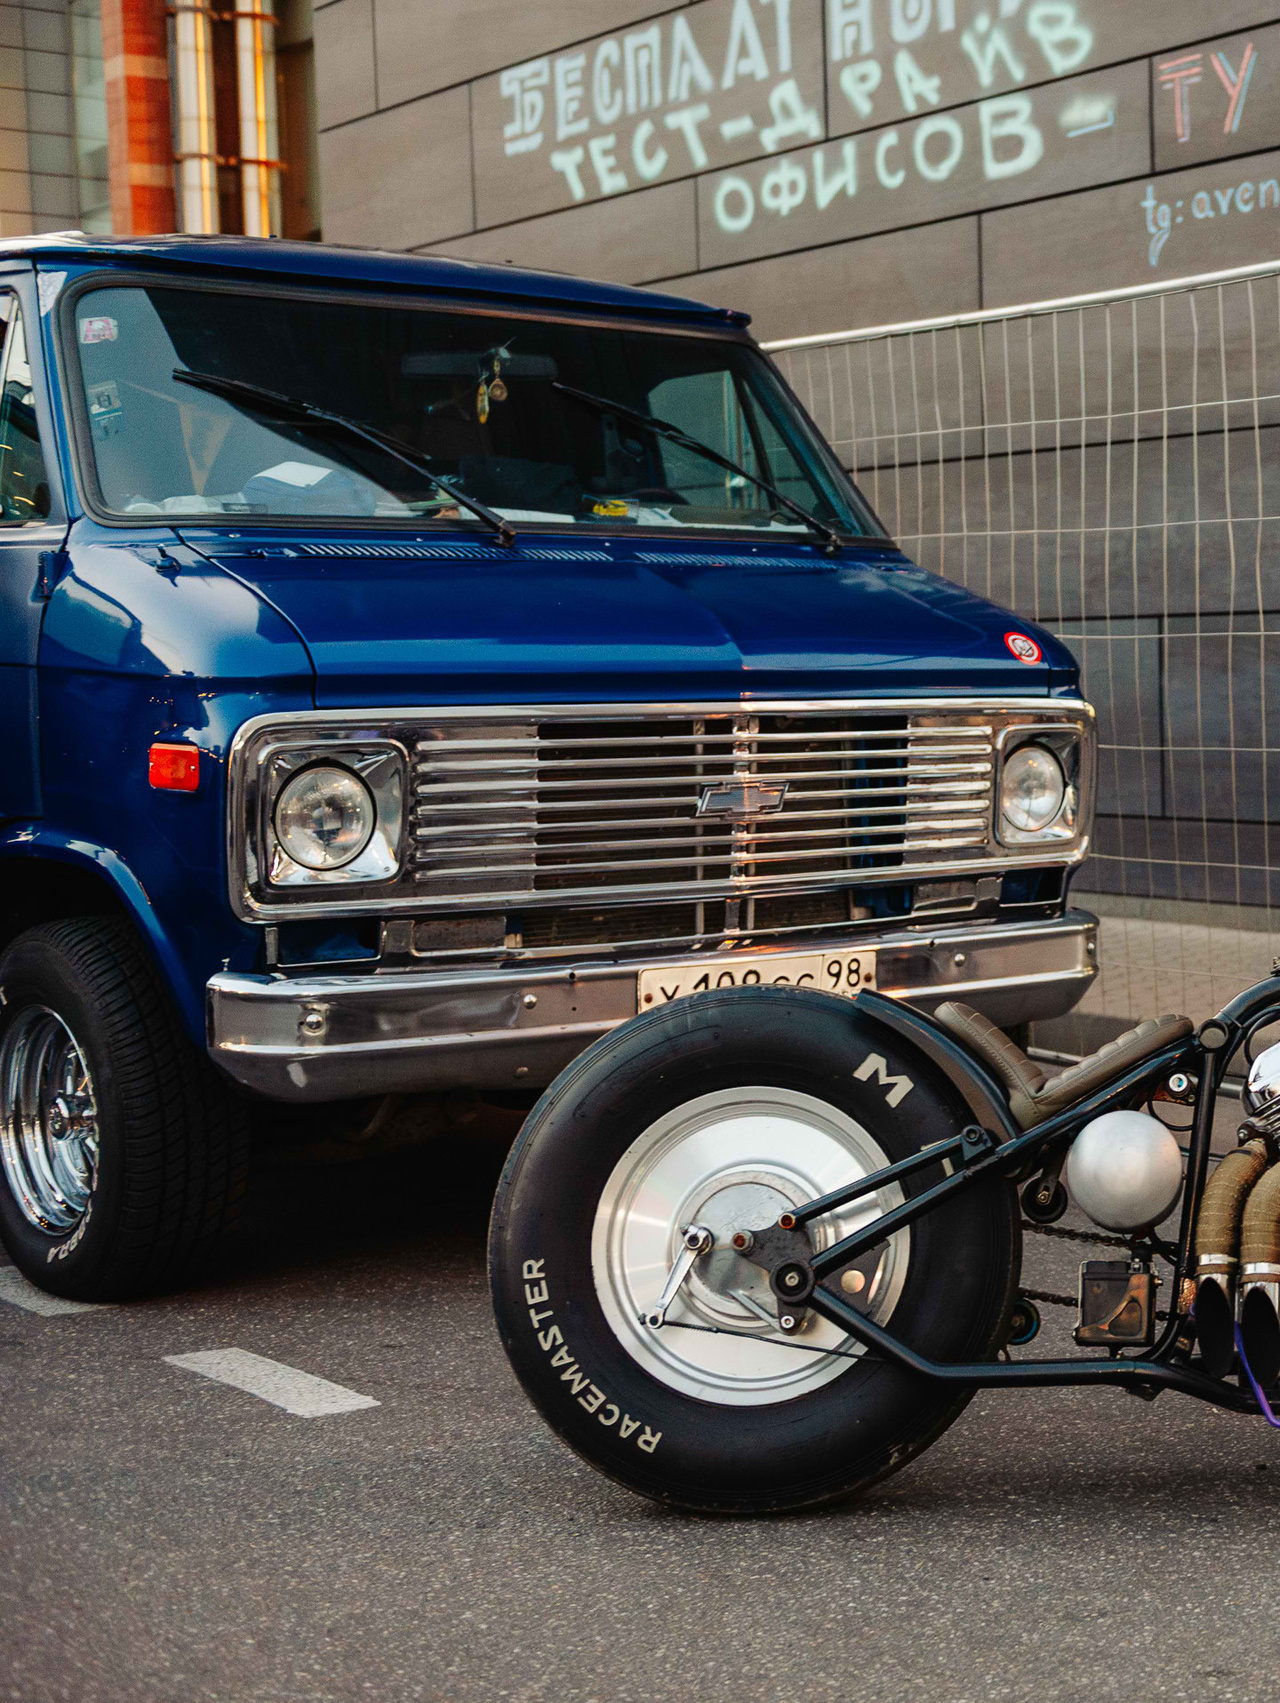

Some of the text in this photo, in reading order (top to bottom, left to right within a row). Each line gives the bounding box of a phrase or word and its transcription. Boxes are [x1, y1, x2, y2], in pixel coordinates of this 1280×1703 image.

[500, 0, 1022, 156] БЕСПЛАТНЫ
[714, 97, 1044, 232] ОФИСОВ
[827, 958, 861, 988] 98
[522, 1258, 663, 1454] RACEMASTER
